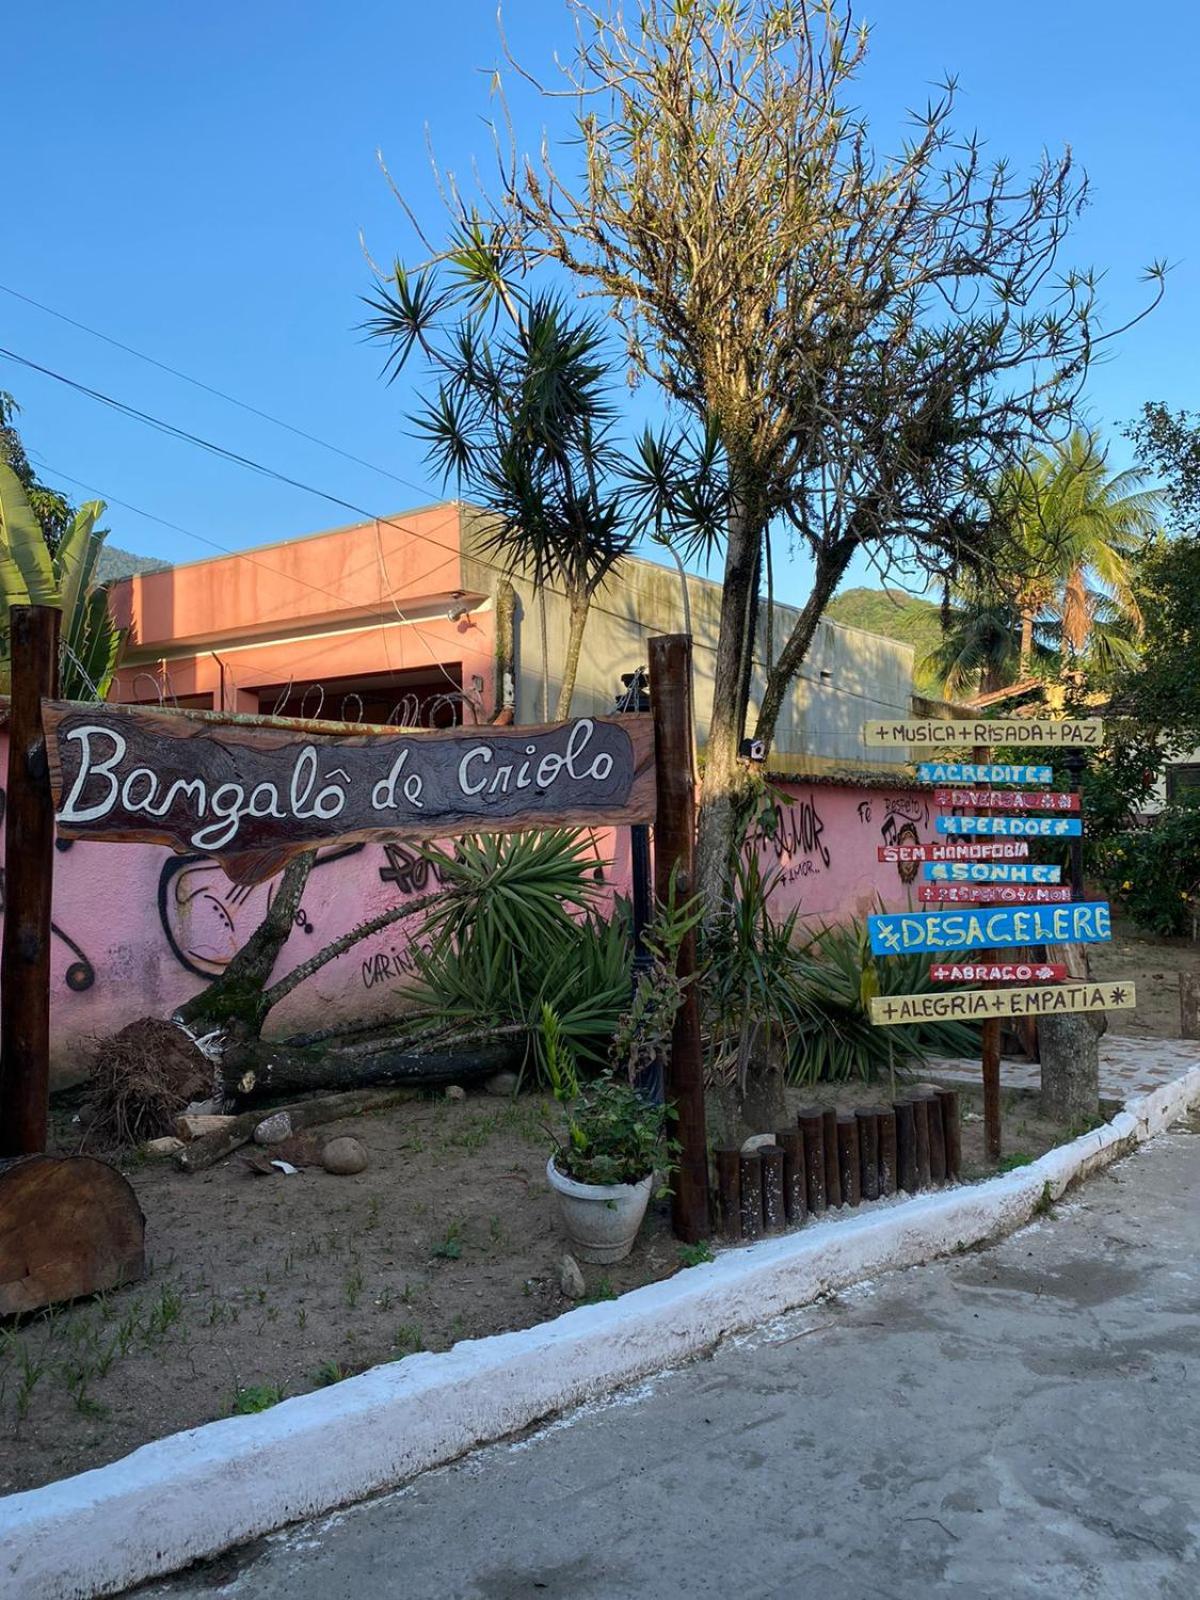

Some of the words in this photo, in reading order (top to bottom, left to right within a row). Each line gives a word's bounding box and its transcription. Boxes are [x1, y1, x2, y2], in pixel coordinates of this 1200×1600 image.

[56, 725, 351, 850] Bangalô
[371, 749, 423, 810] de
[458, 719, 614, 795] Criolo
[884, 846, 926, 862] SEM
[933, 842, 1029, 860] HOMOFOBIA
